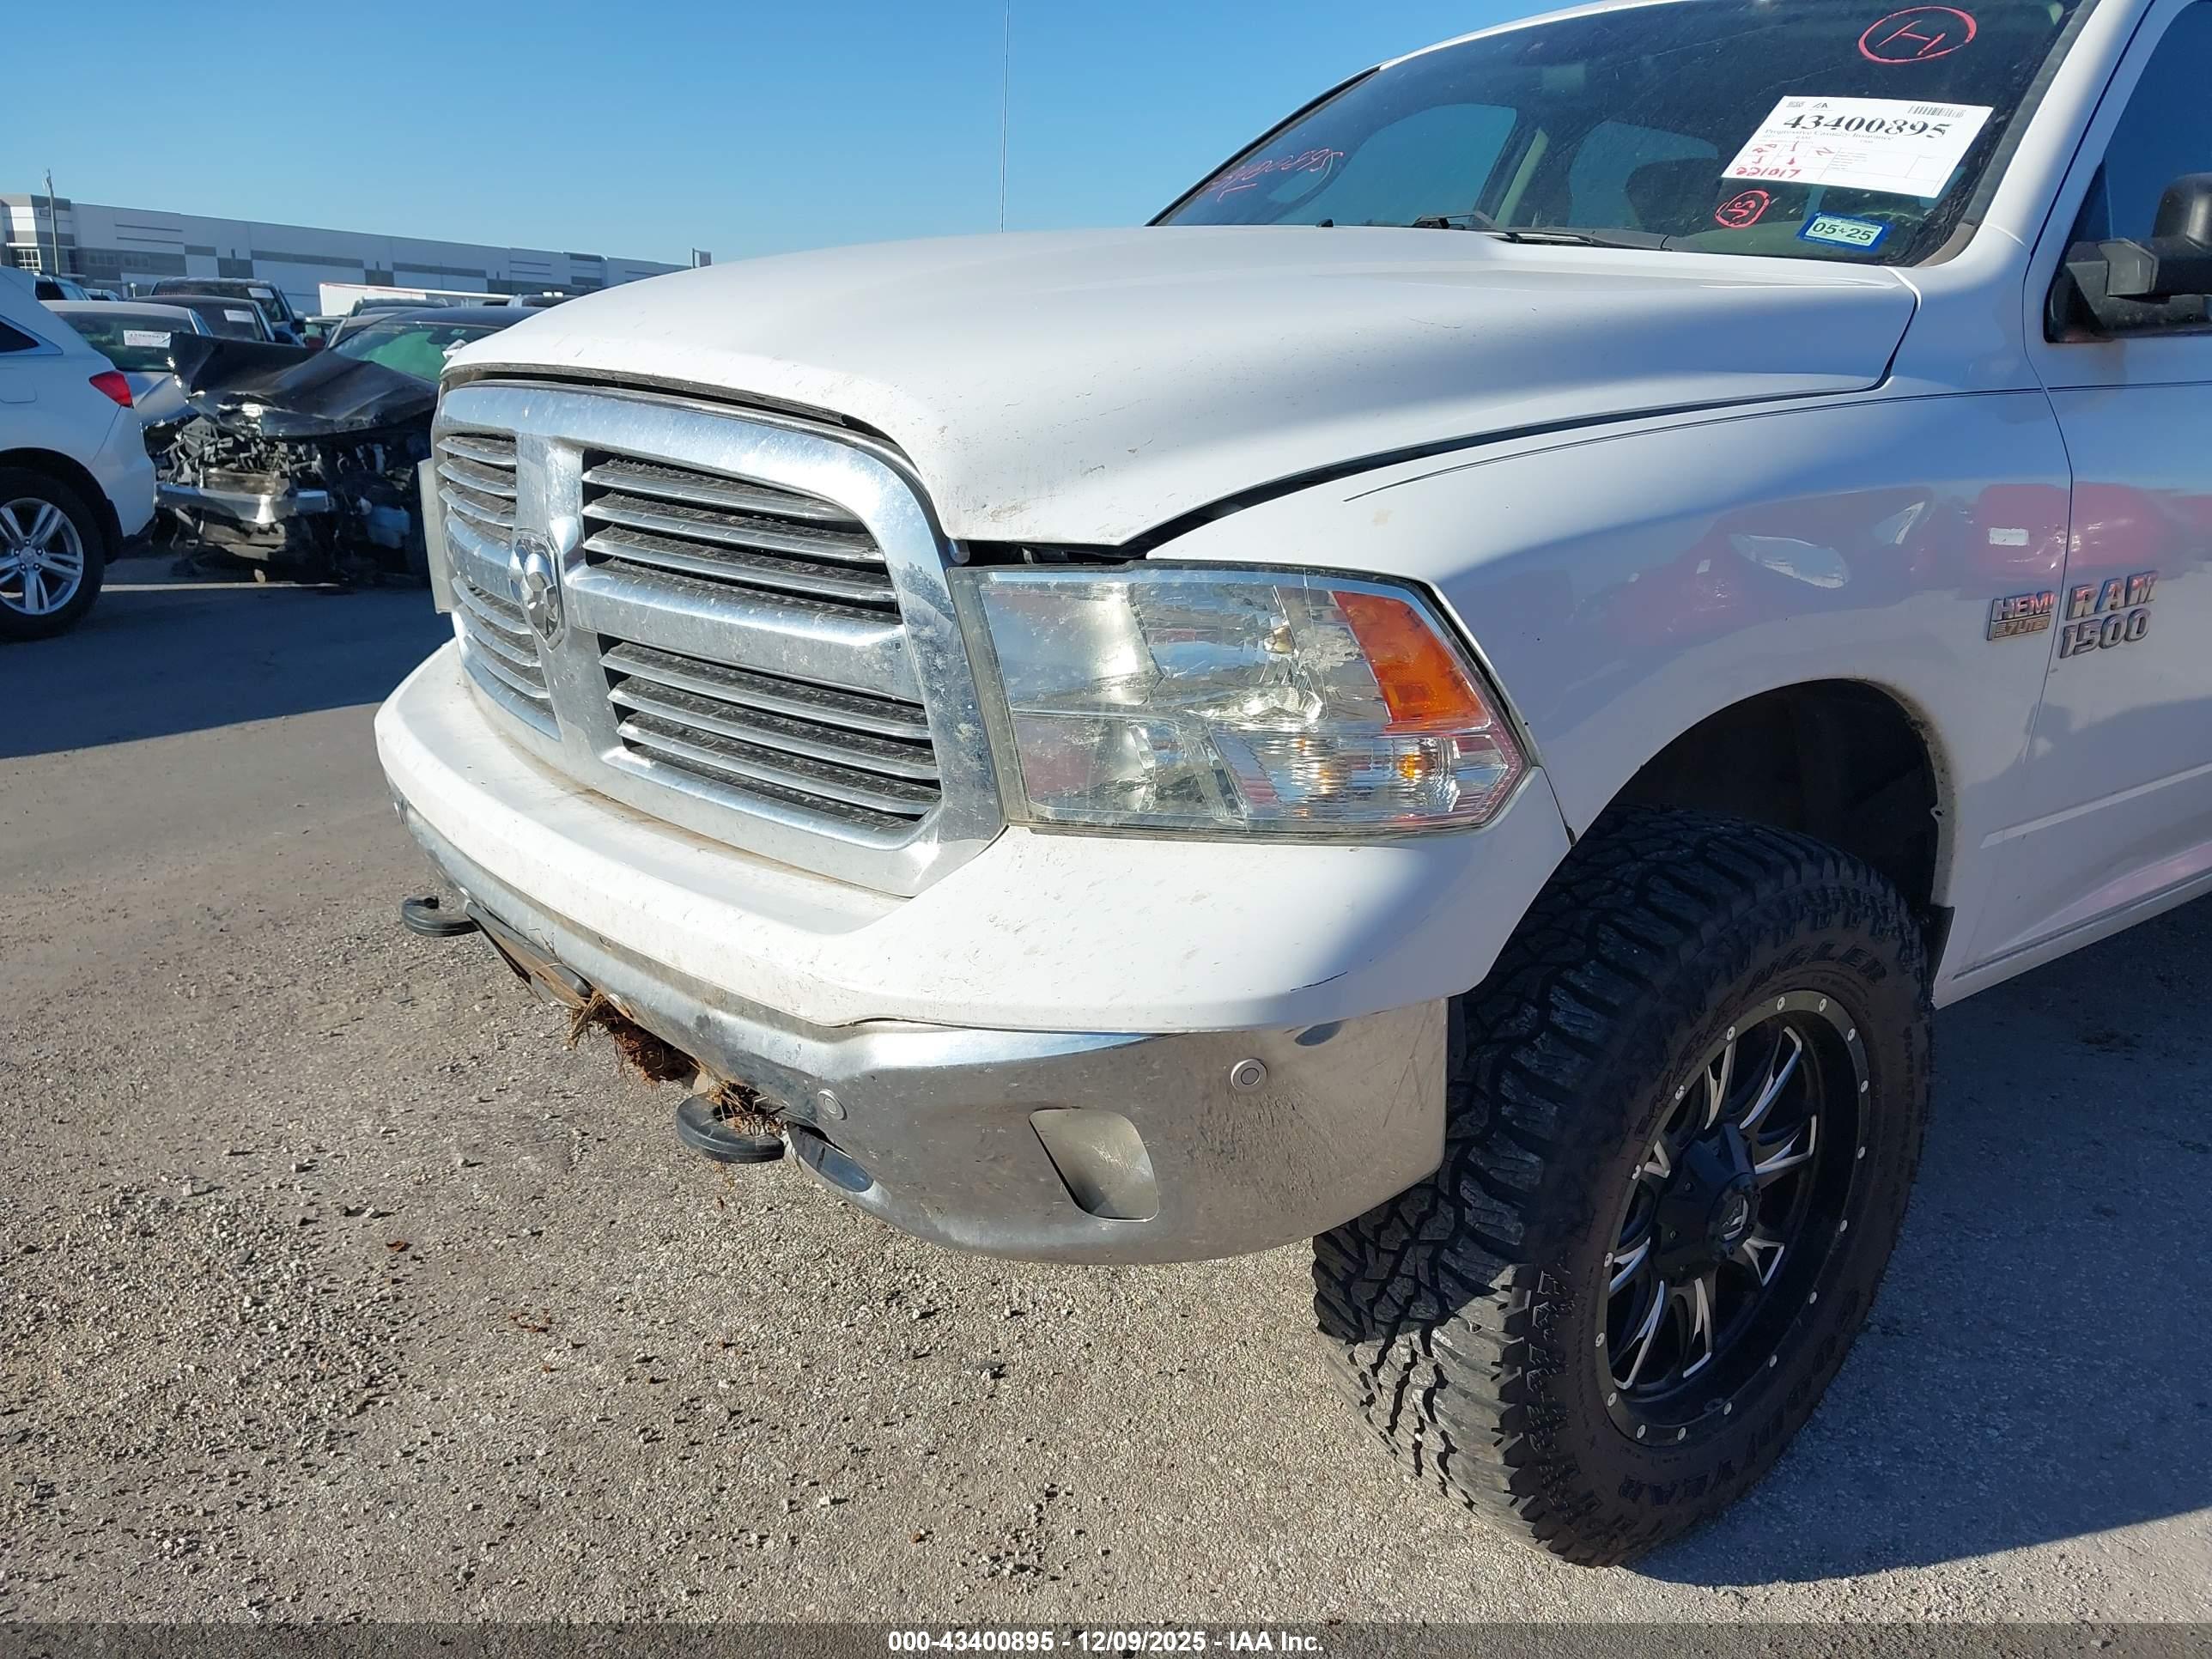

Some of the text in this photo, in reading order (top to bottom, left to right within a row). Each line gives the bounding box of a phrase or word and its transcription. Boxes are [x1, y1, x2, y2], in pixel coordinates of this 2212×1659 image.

[1784, 114, 1951, 138] 43400895
[1813, 222, 1839, 234] 05
[1845, 228, 1874, 241] 25
[1992, 591, 2055, 621] HEMI
[2067, 570, 2159, 620] RAM
[2060, 608, 2151, 659] 1500
